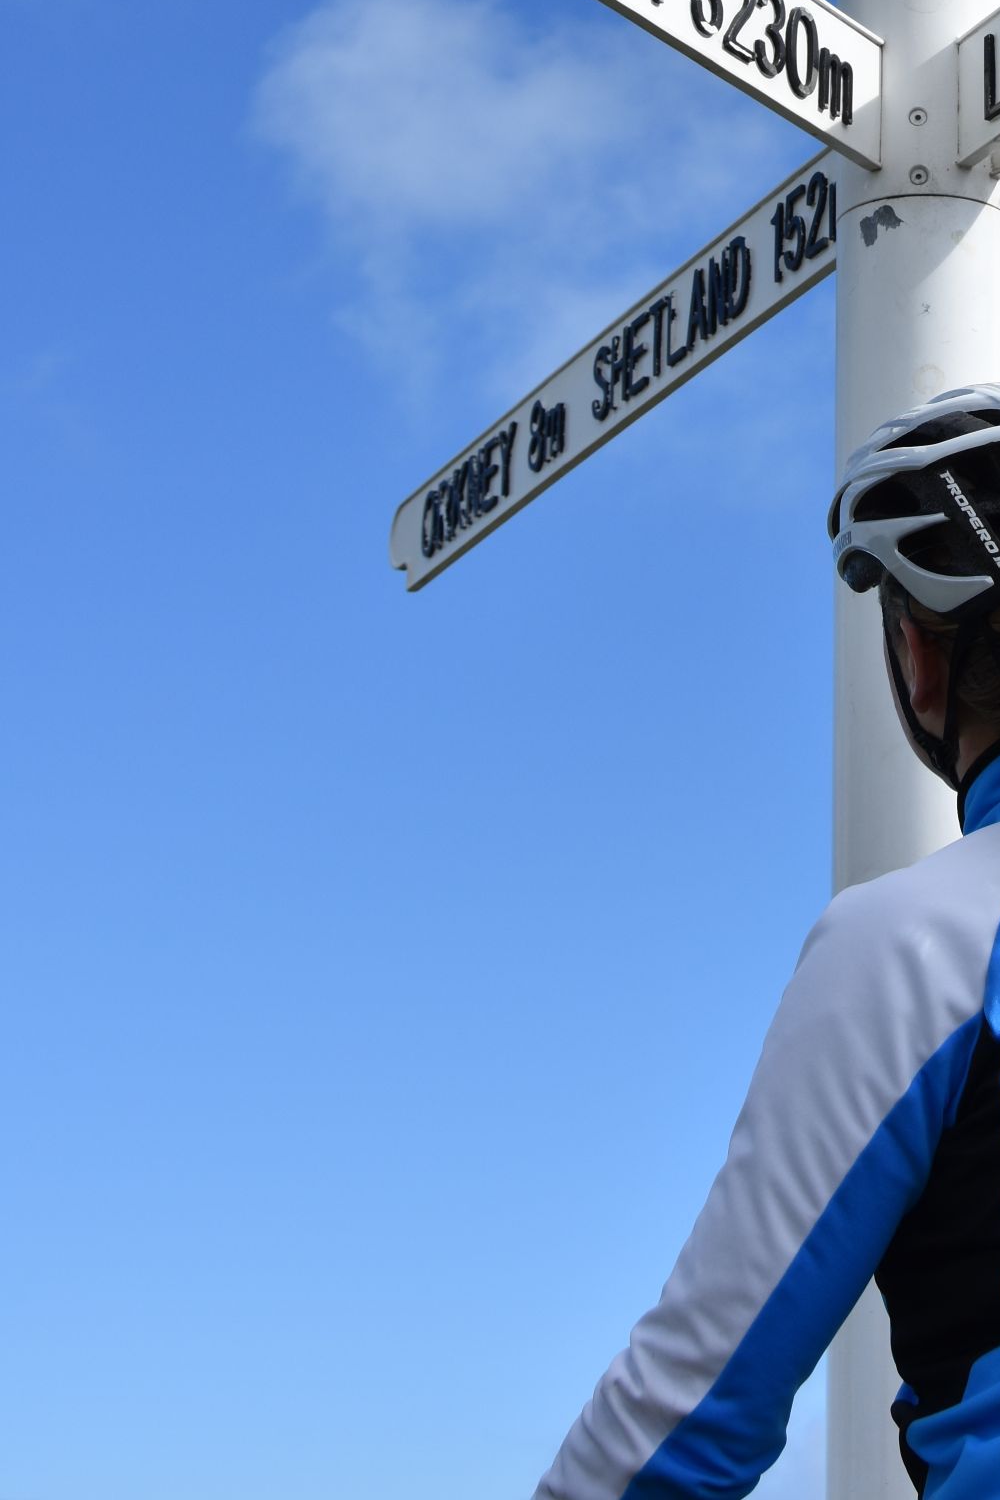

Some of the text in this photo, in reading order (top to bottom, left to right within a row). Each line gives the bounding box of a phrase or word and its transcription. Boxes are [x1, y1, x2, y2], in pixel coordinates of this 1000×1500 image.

[421, 421, 518, 558] ORKNEY
[528, 400, 566, 473] 8m
[592, 236, 752, 421] SHETLAND
[939, 469, 999, 554] PROPERO
